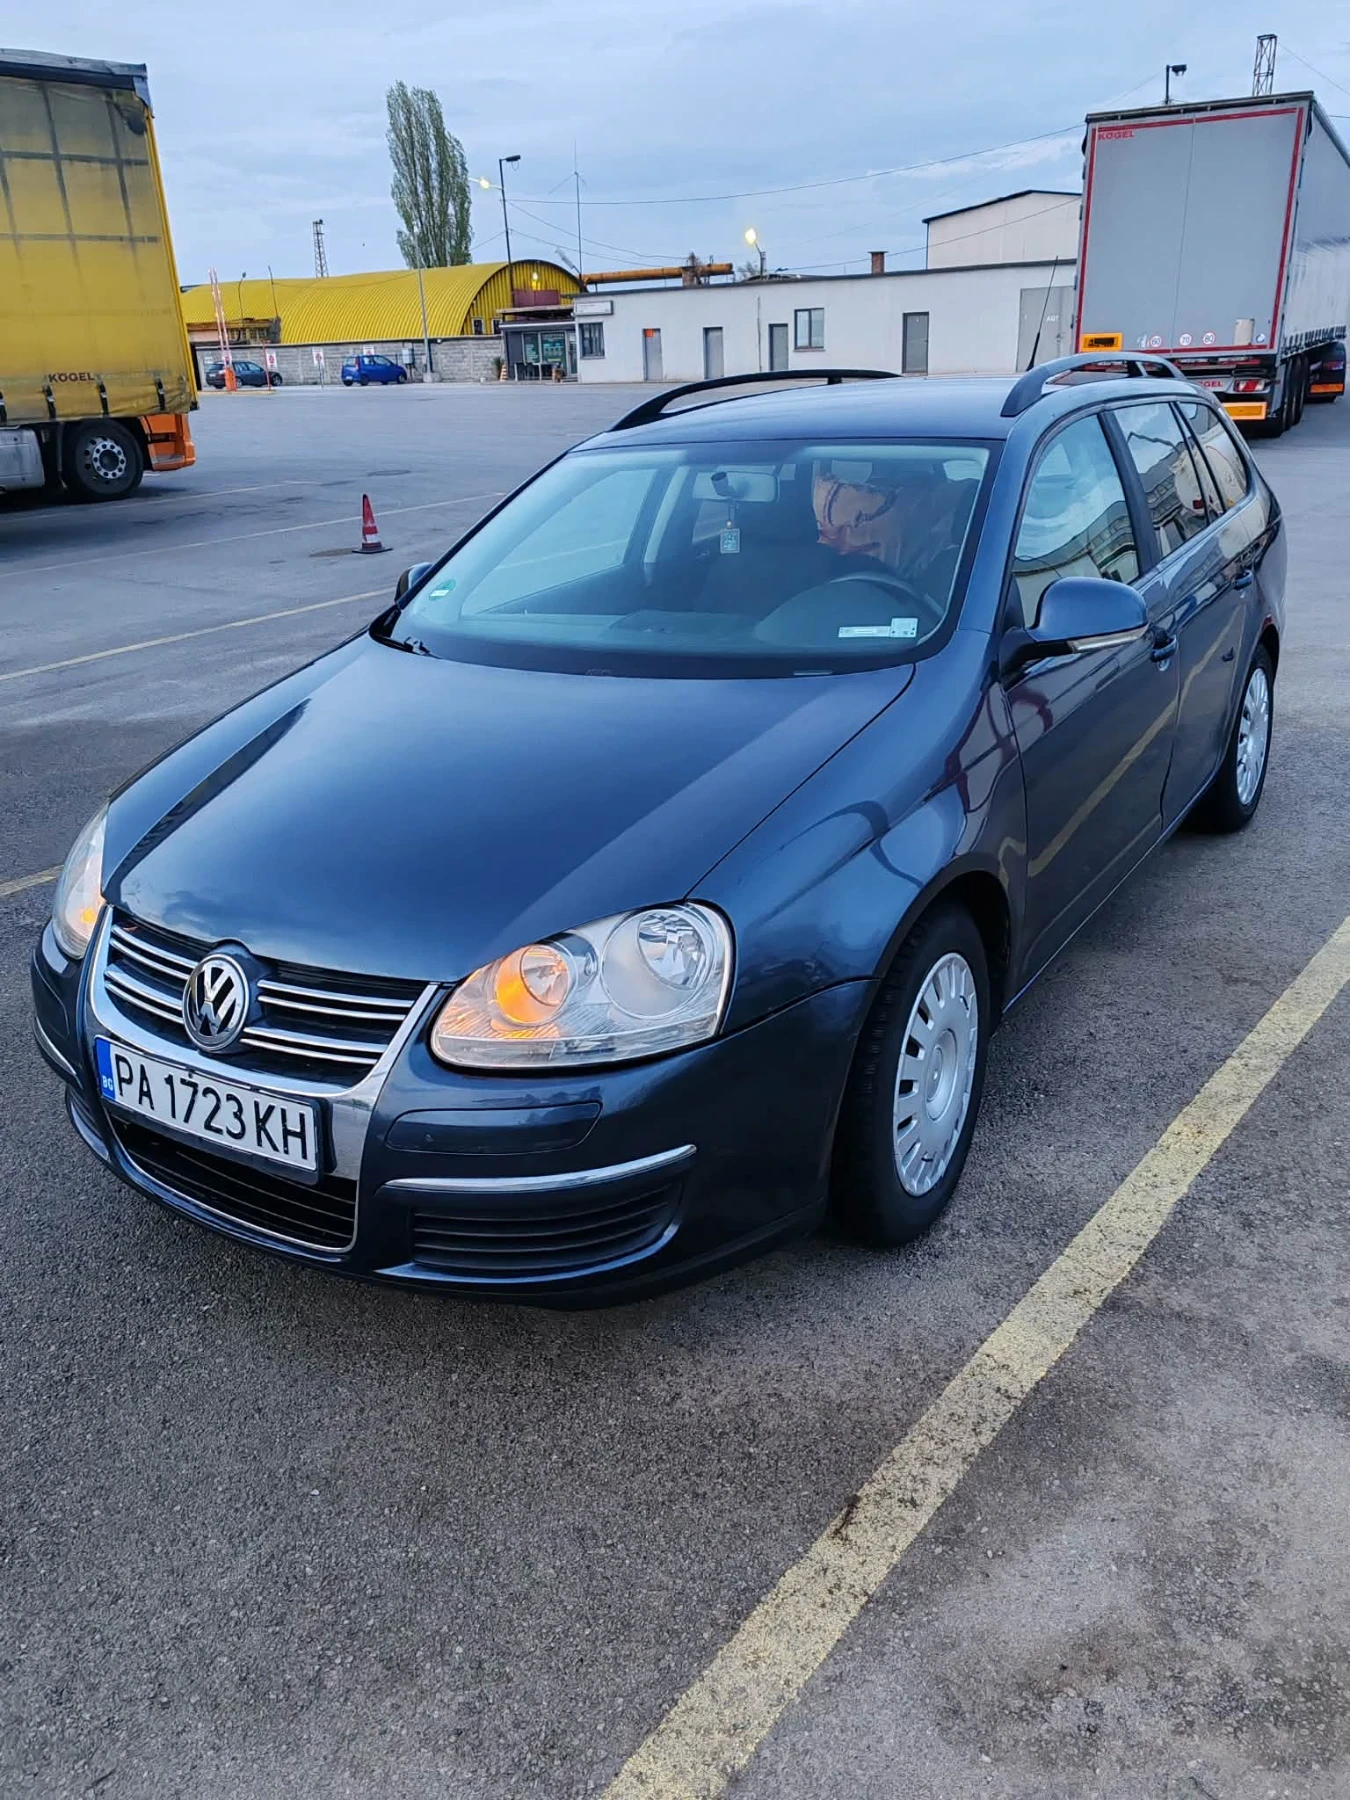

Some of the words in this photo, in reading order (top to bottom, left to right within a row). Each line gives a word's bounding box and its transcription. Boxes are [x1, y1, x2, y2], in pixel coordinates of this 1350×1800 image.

[184, 955, 248, 1049] VW
[102, 1074, 114, 1091] BG
[115, 1053, 154, 1110] PA
[164, 1073, 246, 1140] 1723
[253, 1100, 308, 1160] KH
